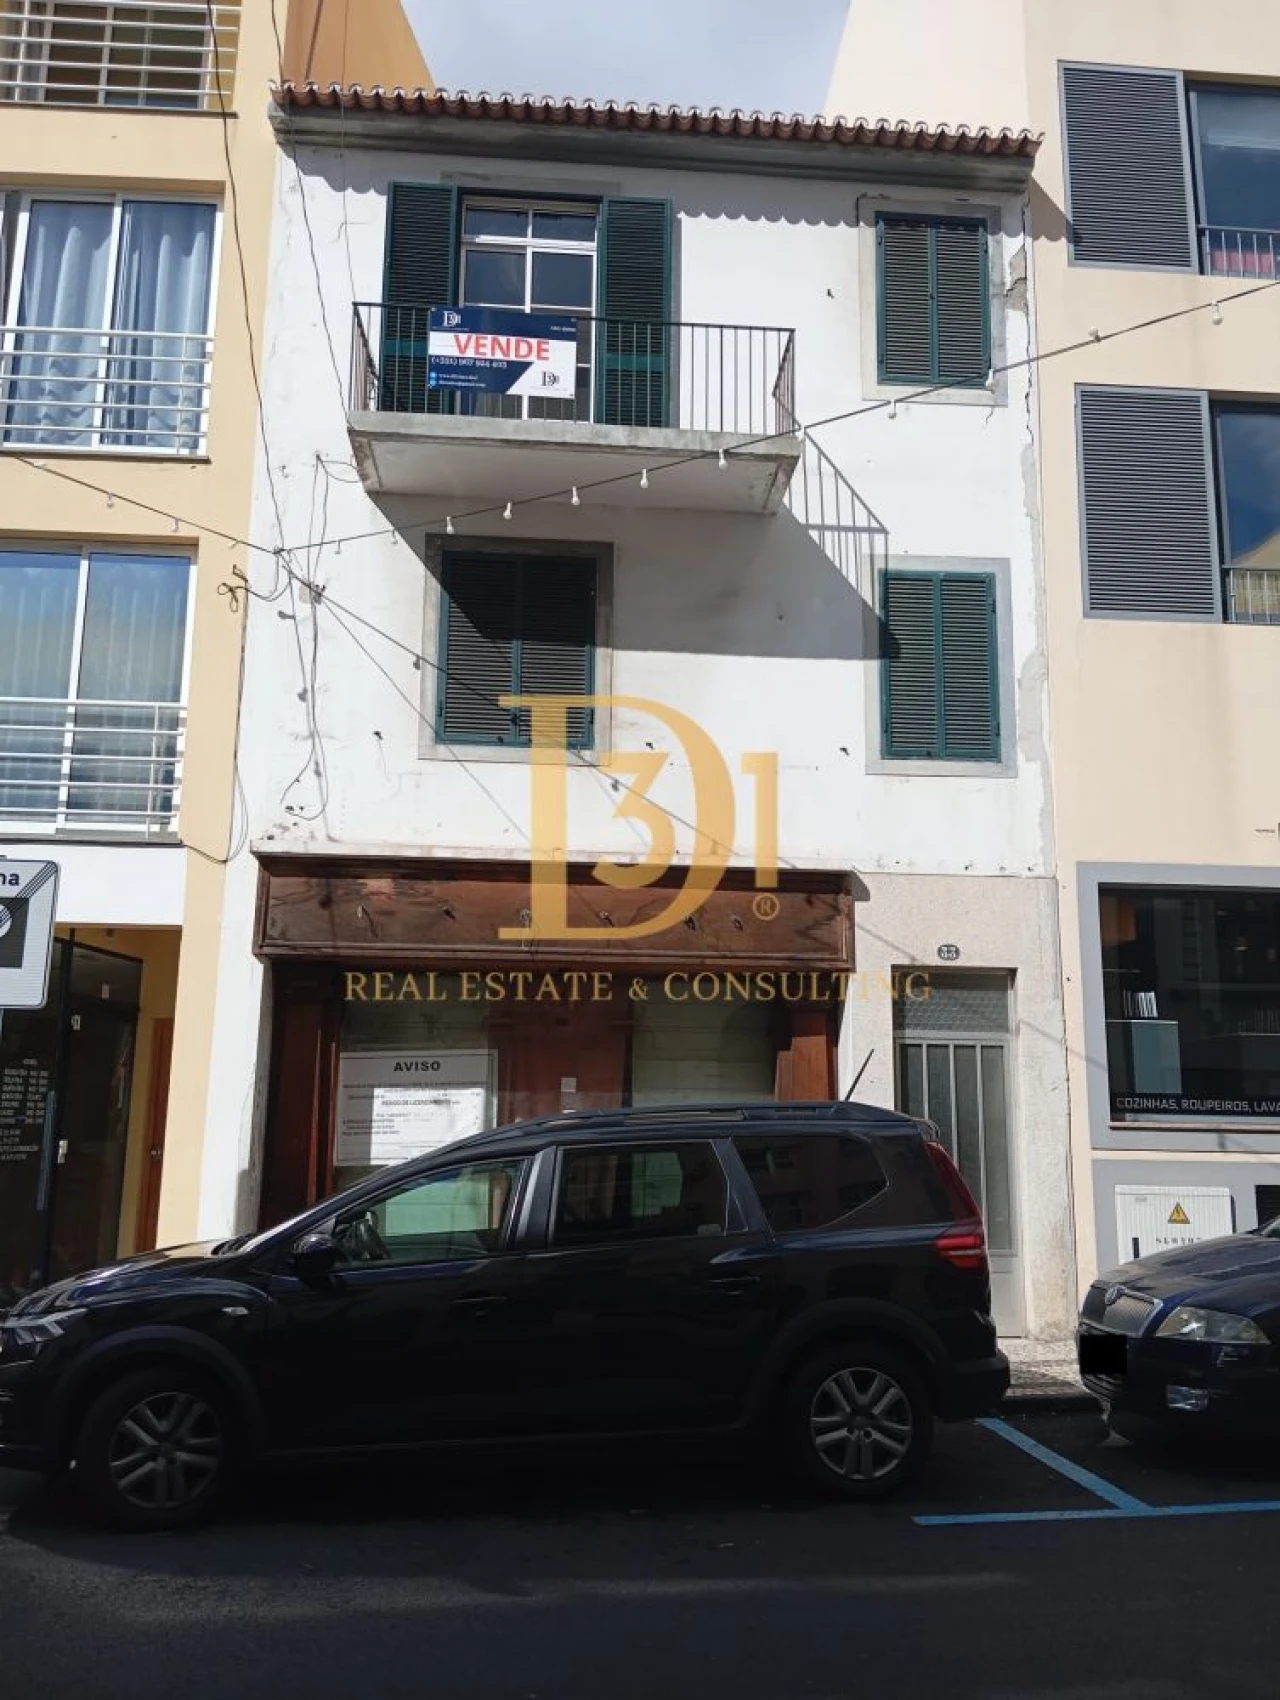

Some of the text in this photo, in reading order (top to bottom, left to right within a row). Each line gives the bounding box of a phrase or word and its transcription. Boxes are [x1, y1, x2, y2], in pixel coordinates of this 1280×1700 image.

[454, 334, 550, 361] VENDE
[393, 1060, 441, 1073] AVISO
[1116, 1097, 1179, 1111] COZINHAS,
[1181, 1099, 1251, 1113] ROUPEIROS,
